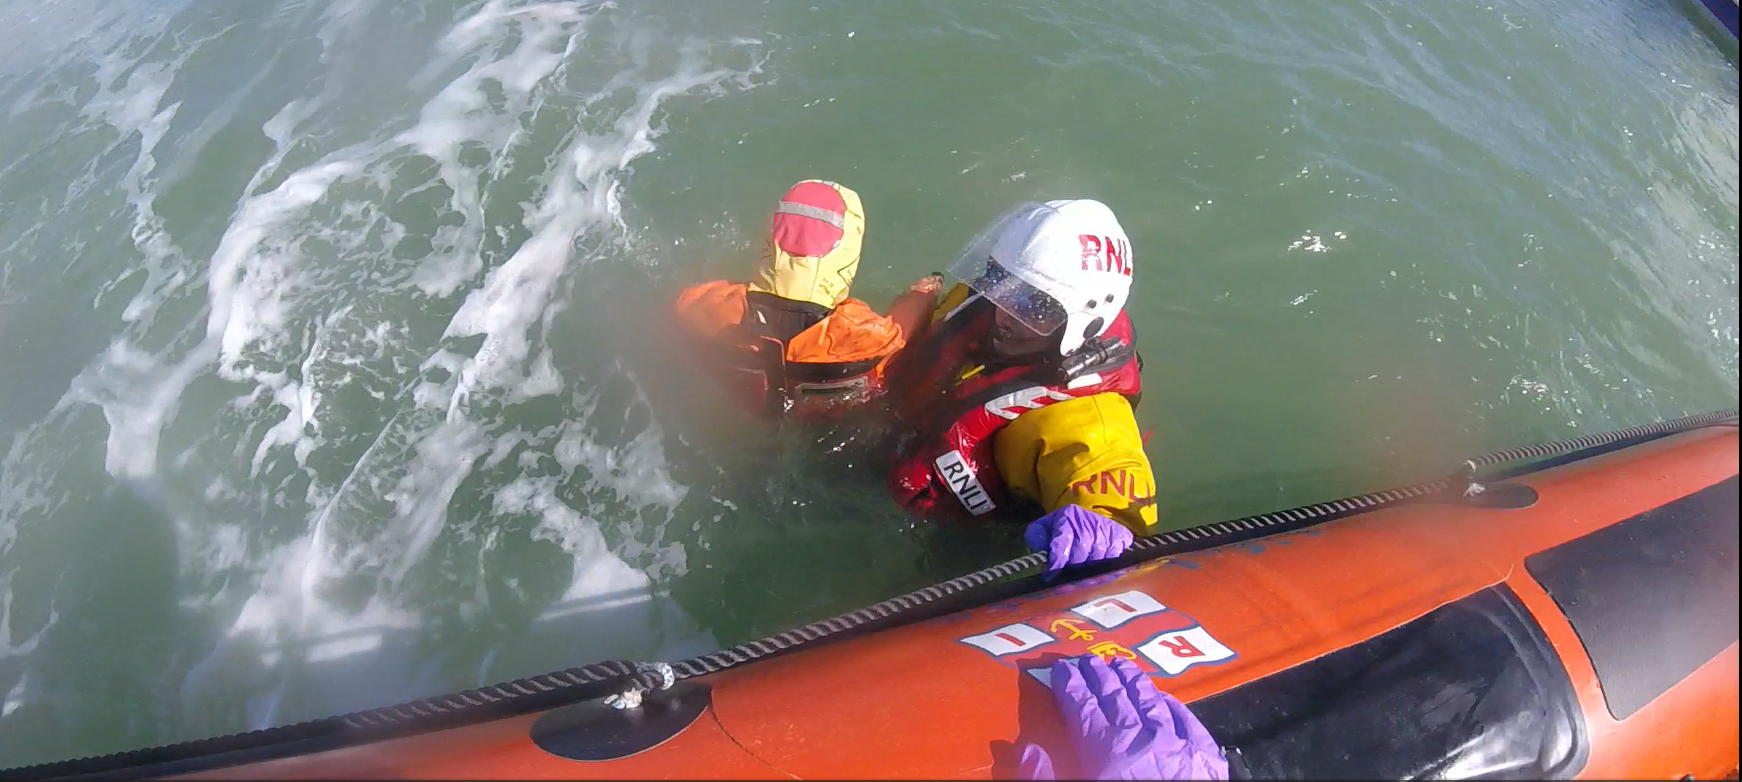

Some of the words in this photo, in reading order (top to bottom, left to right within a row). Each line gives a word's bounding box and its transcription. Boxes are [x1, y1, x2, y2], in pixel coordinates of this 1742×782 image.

[943, 461, 988, 510] RNLI
[1093, 598, 1137, 613] L
[995, 632, 1026, 647] I
[1158, 636, 1205, 657] R
